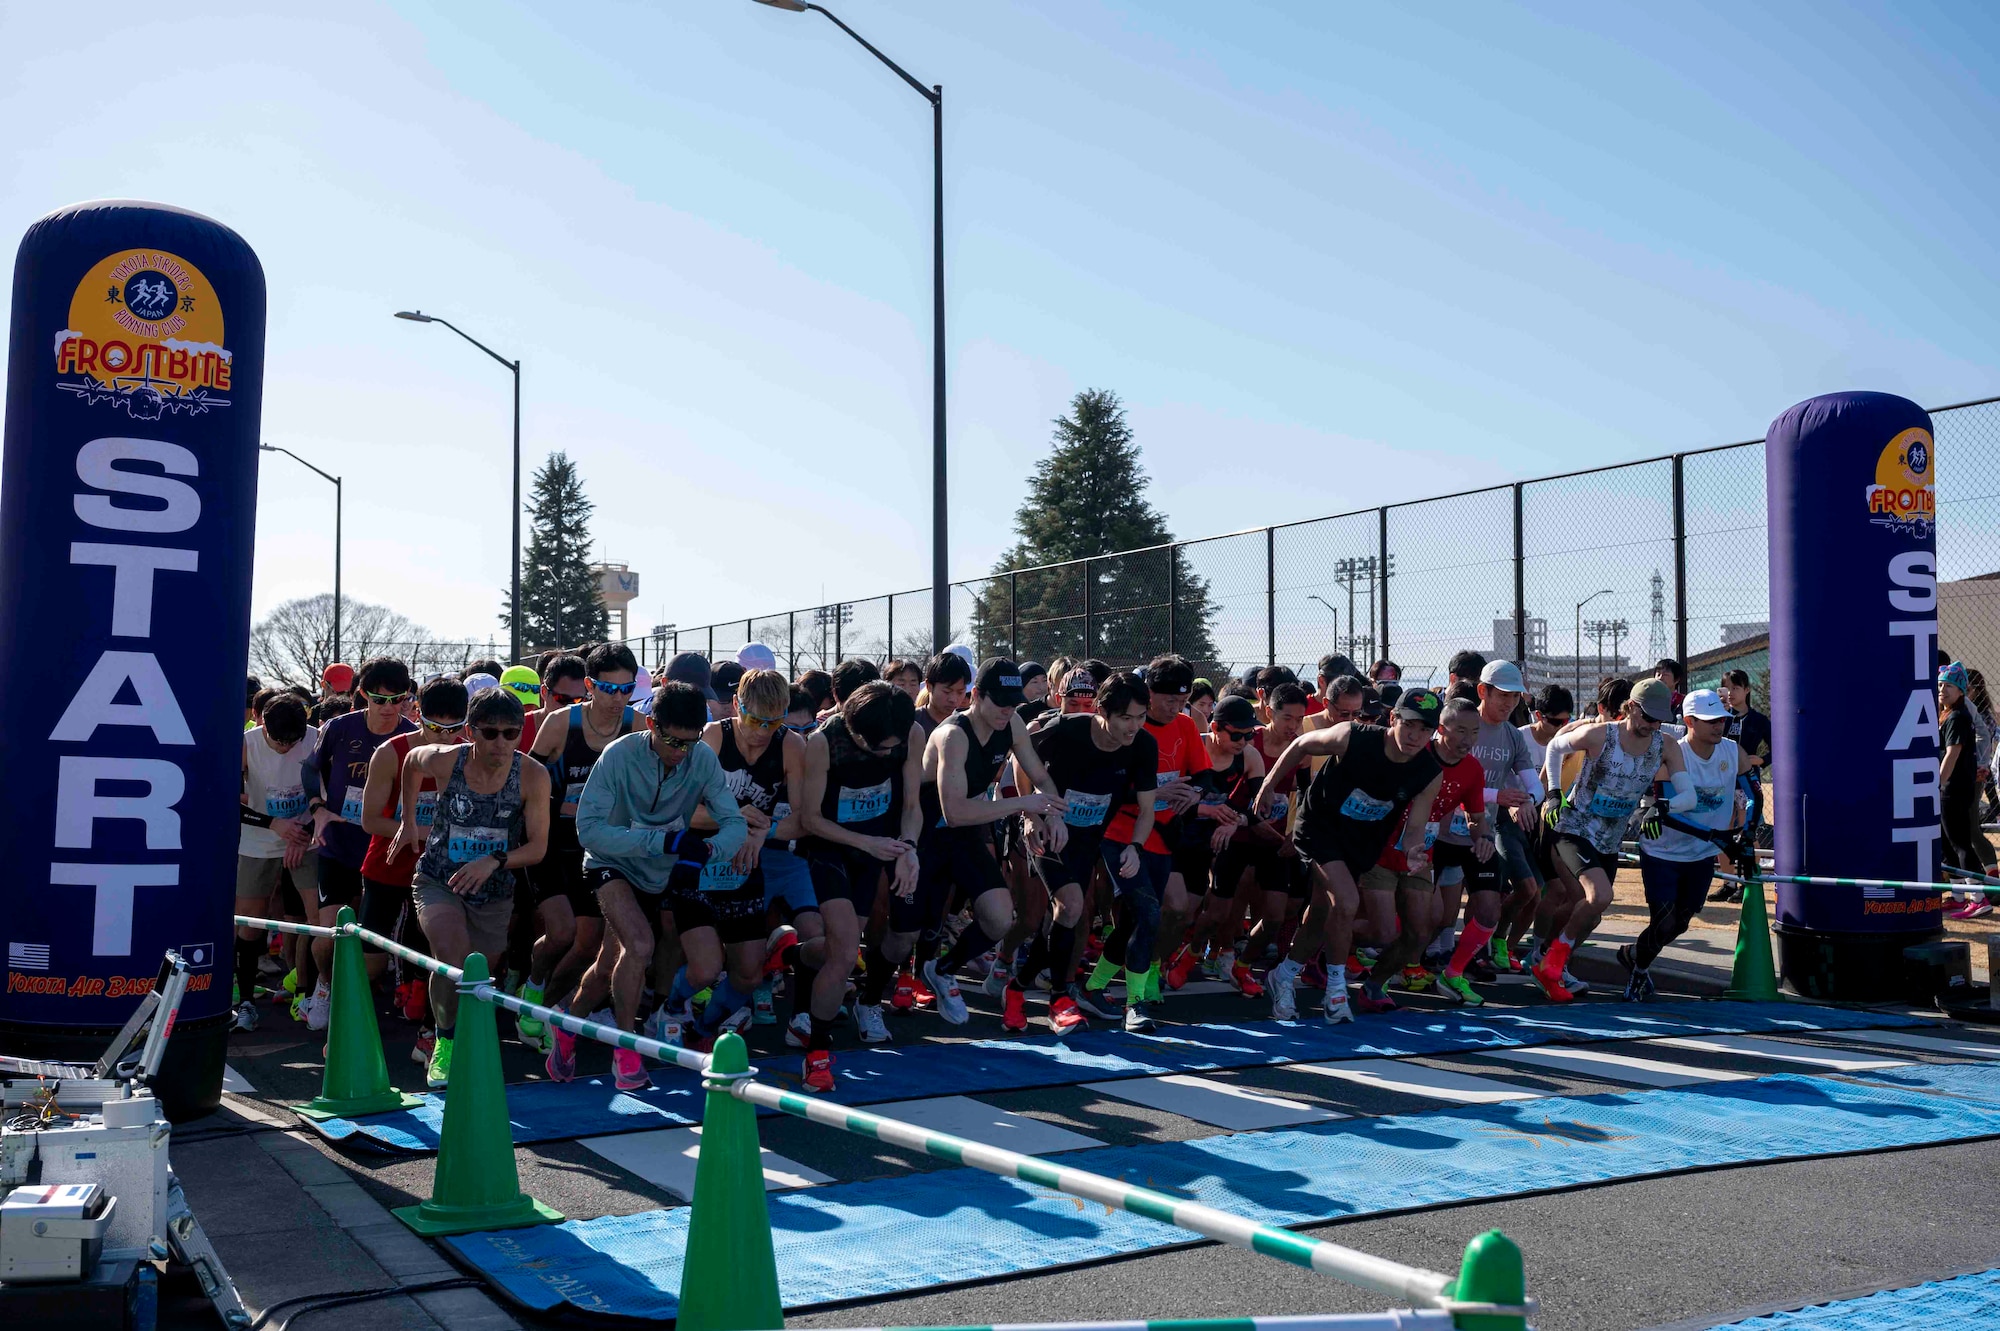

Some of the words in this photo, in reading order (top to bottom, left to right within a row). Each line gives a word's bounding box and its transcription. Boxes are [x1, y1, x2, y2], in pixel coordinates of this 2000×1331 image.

[109, 253, 150, 282] YOKOTA
[151, 254, 194, 292] STRIDERS
[104, 285, 123, 304] 東
[180, 295, 195, 313] 京
[112, 308, 158, 338] RUNNING
[160, 314, 187, 336] CLUB
[136, 307, 164, 318] JAPAN
[57, 338, 232, 390] FROSTBITE
[48, 436, 201, 957] START
[7, 971, 67, 995] YOKOTA
[68, 975, 105, 997] AIR
[105, 976, 157, 998] BASE
